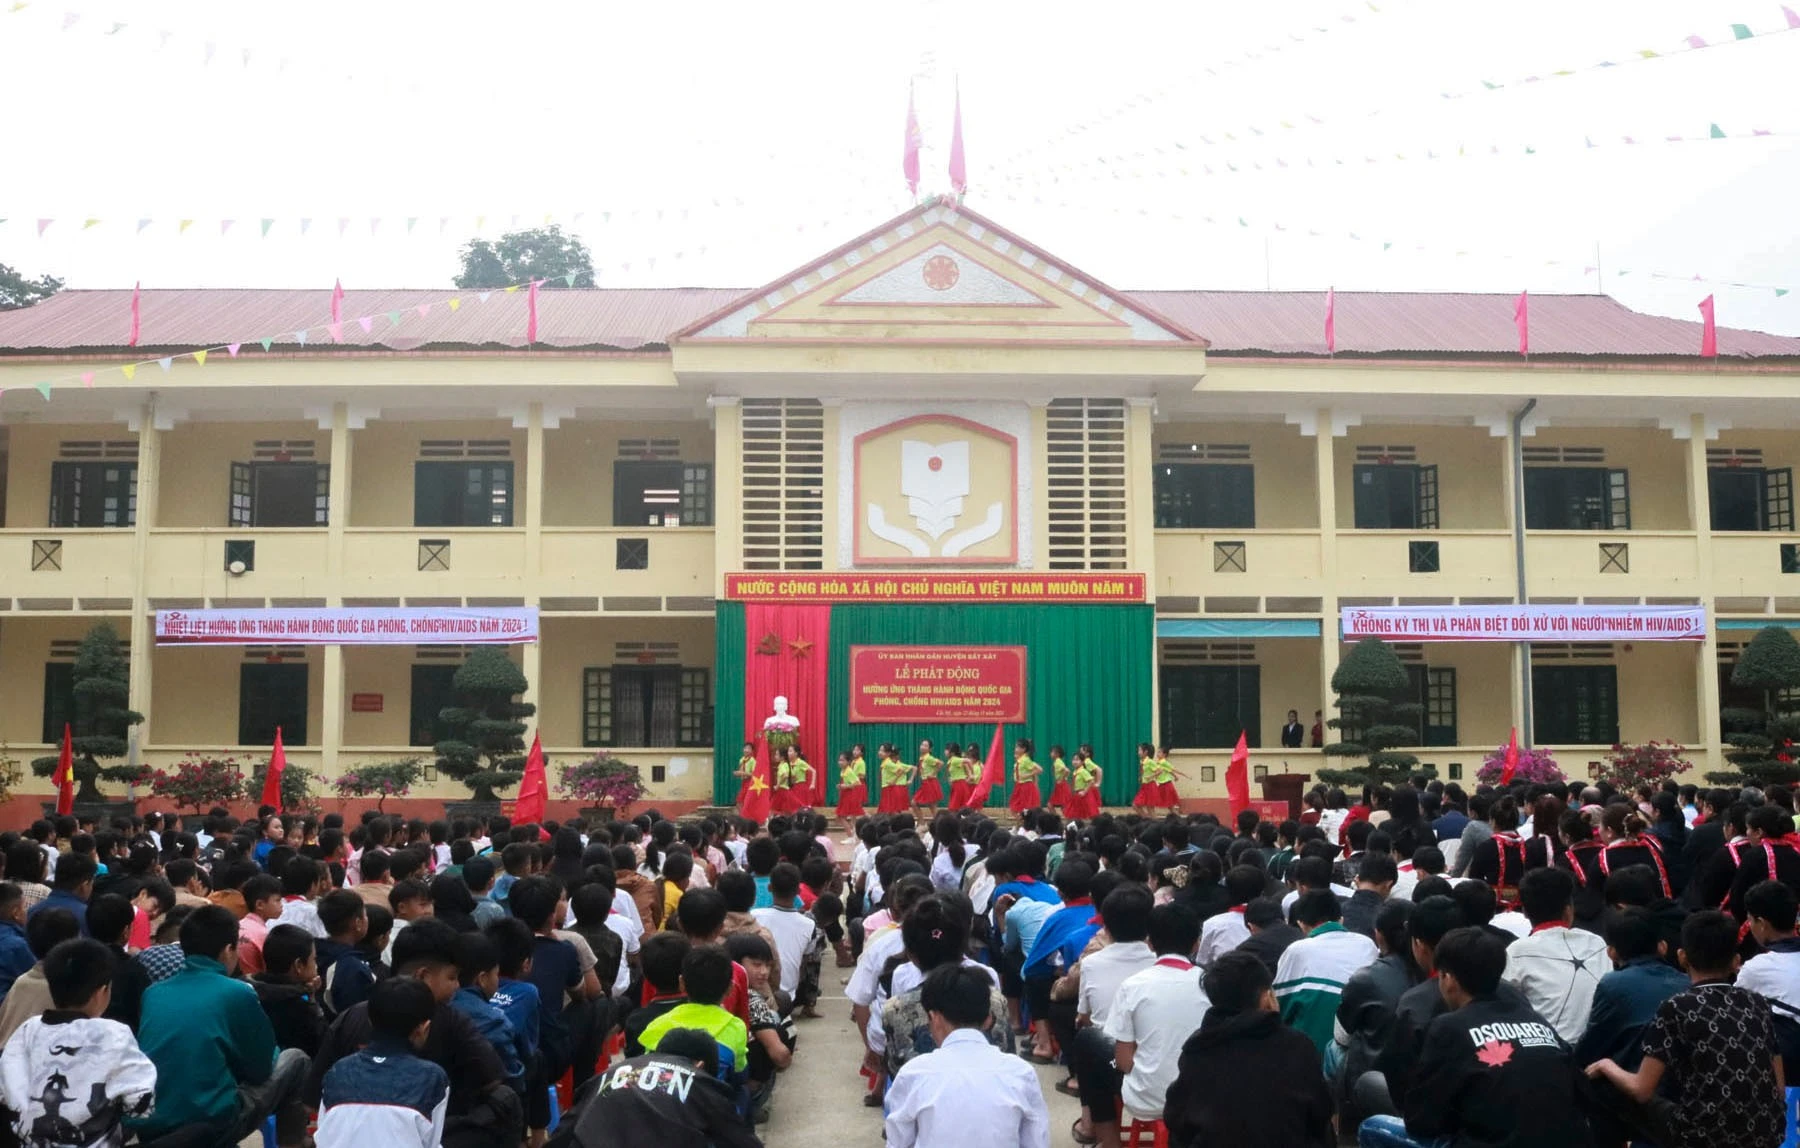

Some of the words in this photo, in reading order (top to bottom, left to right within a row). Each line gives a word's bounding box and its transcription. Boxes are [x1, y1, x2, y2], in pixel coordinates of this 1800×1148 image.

[737, 579, 775, 595] NƯỚC
[779, 580, 817, 597] CỘNG
[821, 579, 849, 595] HÒA
[852, 580, 871, 595] XÃ
[874, 580, 898, 597] HỘI
[901, 577, 929, 595] CHỦ
[933, 580, 976, 595] NGHĨA
[979, 580, 1008, 597] VIỆT
[1011, 582, 1044, 595] NAM
[1047, 580, 1089, 595] MUÔN
[1092, 580, 1125, 595] NĂM
[208, 615, 236, 635] HƯỞNG
[239, 617, 256, 634] ỨNG
[259, 617, 285, 634] THÁNG
[287, 616, 310, 634] HÀNH
[312, 616, 335, 637] ĐỘNG
[337, 614, 359, 634] QUỐC
[361, 619, 375, 634] GIA
[441, 618, 477, 633] HIV/AIDS
[480, 616, 499, 633] NĂM
[1352, 615, 1392, 633] KHÔNG
[1412, 618, 1430, 635] THỊ
[1433, 615, 1448, 632] VÀ
[1450, 615, 1482, 632] PHÂN
[1484, 614, 1508, 635] BIỆT
[1511, 613, 1530, 631] ĐỐI
[1533, 613, 1549, 631] XỬ
[1551, 614, 1569, 631] VỚI
[1645, 617, 1692, 632] HIV/AIDS
[895, 662, 910, 679] LỄ
[913, 665, 944, 679] PHÁT
[947, 665, 980, 682] ĐỘNG
